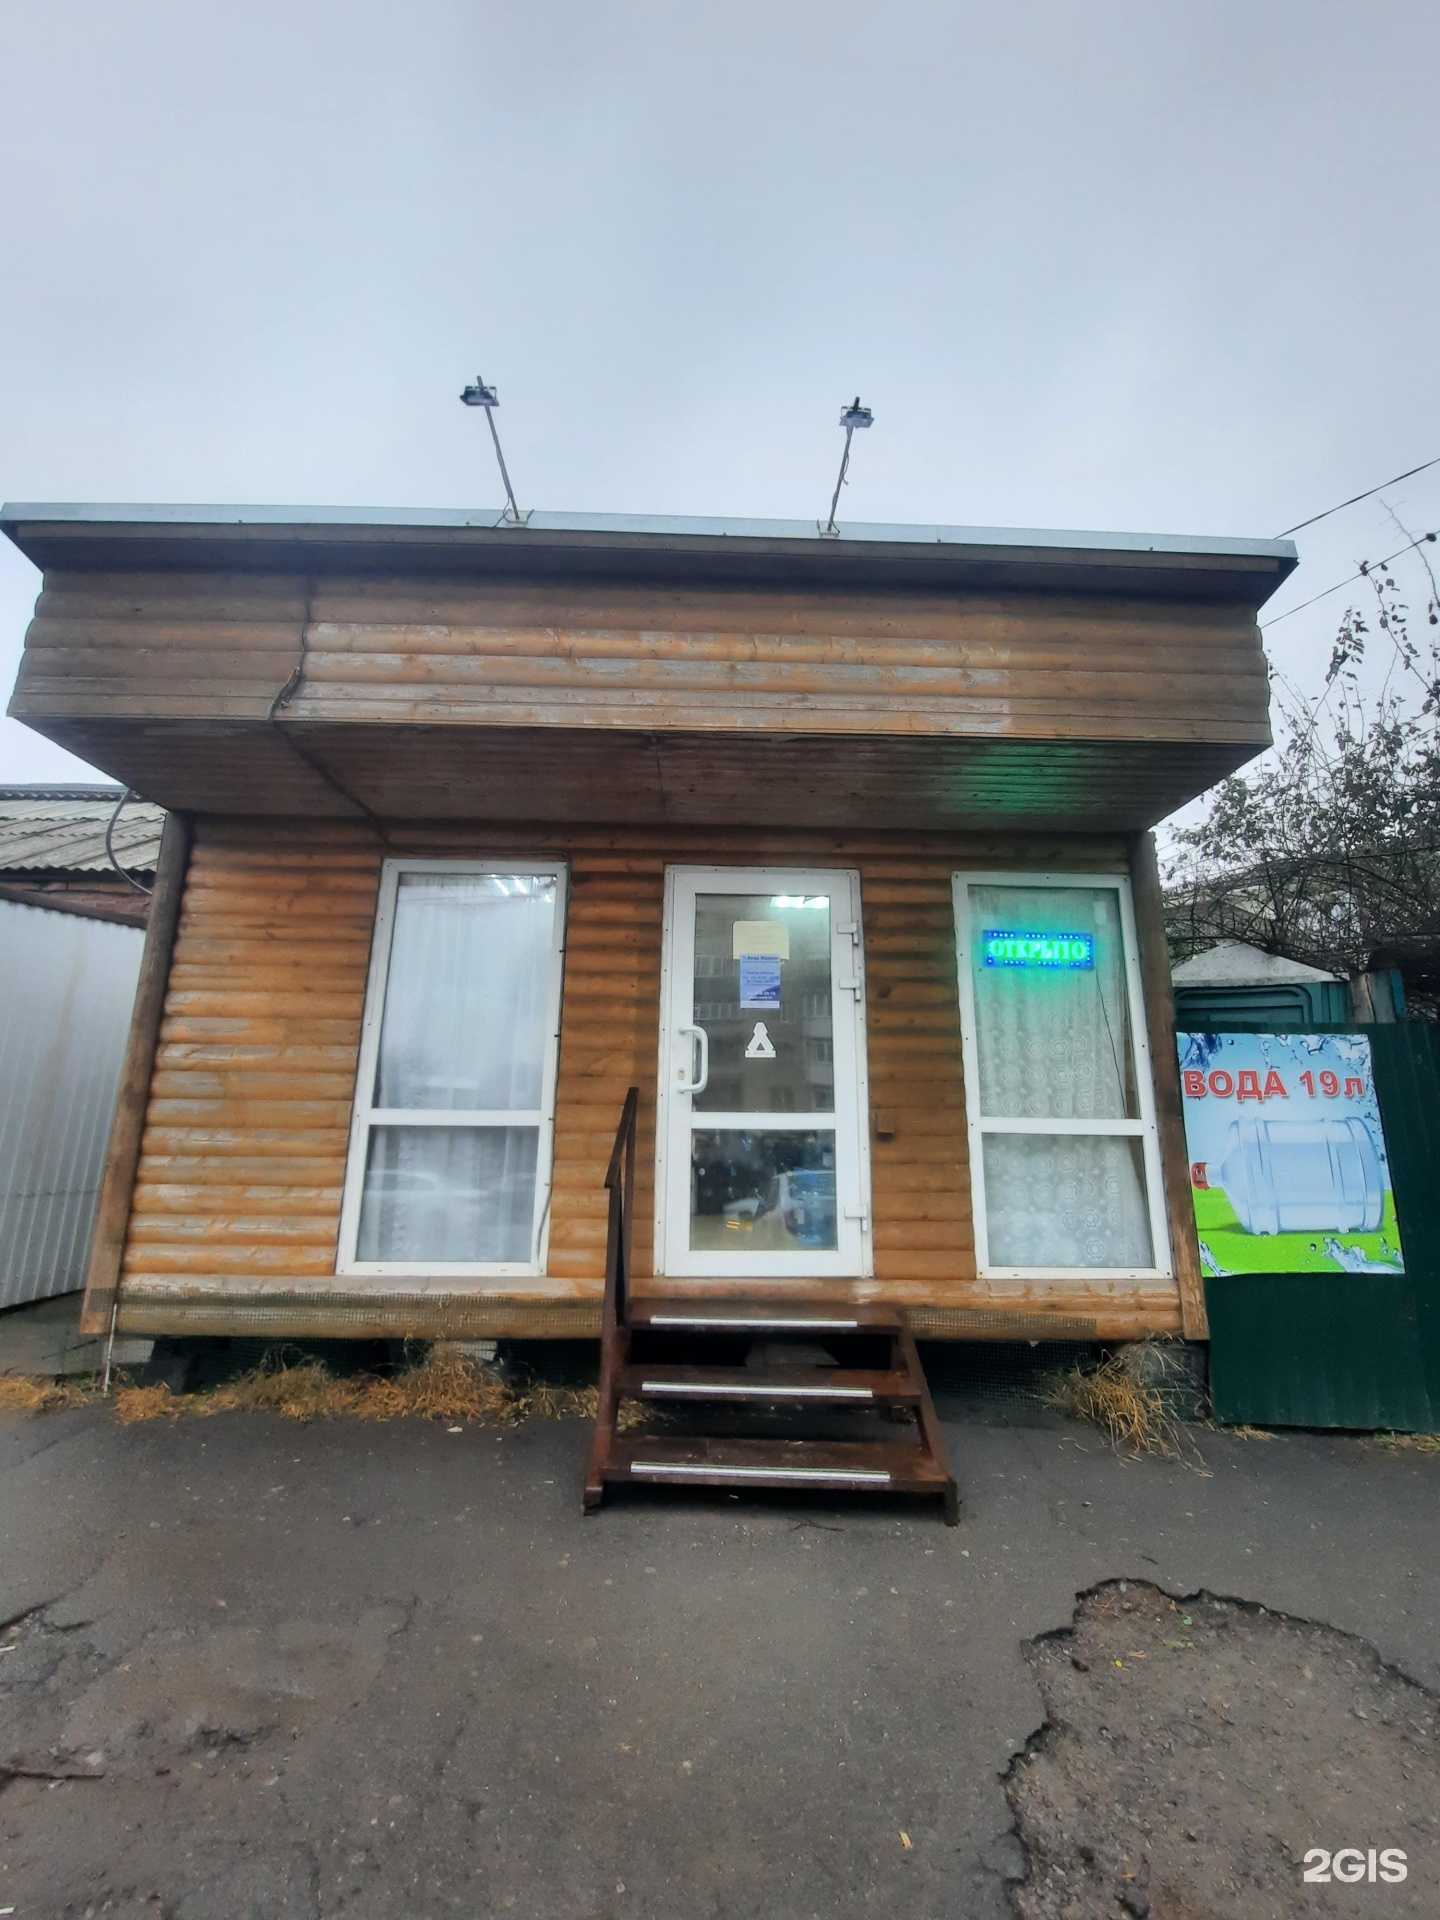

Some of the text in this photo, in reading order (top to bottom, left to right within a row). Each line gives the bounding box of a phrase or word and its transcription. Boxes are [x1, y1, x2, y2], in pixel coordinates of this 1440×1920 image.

[989, 939, 1087, 960] ОТКРЫТО
[1183, 1070, 1365, 1102] ВОДА 19 л
